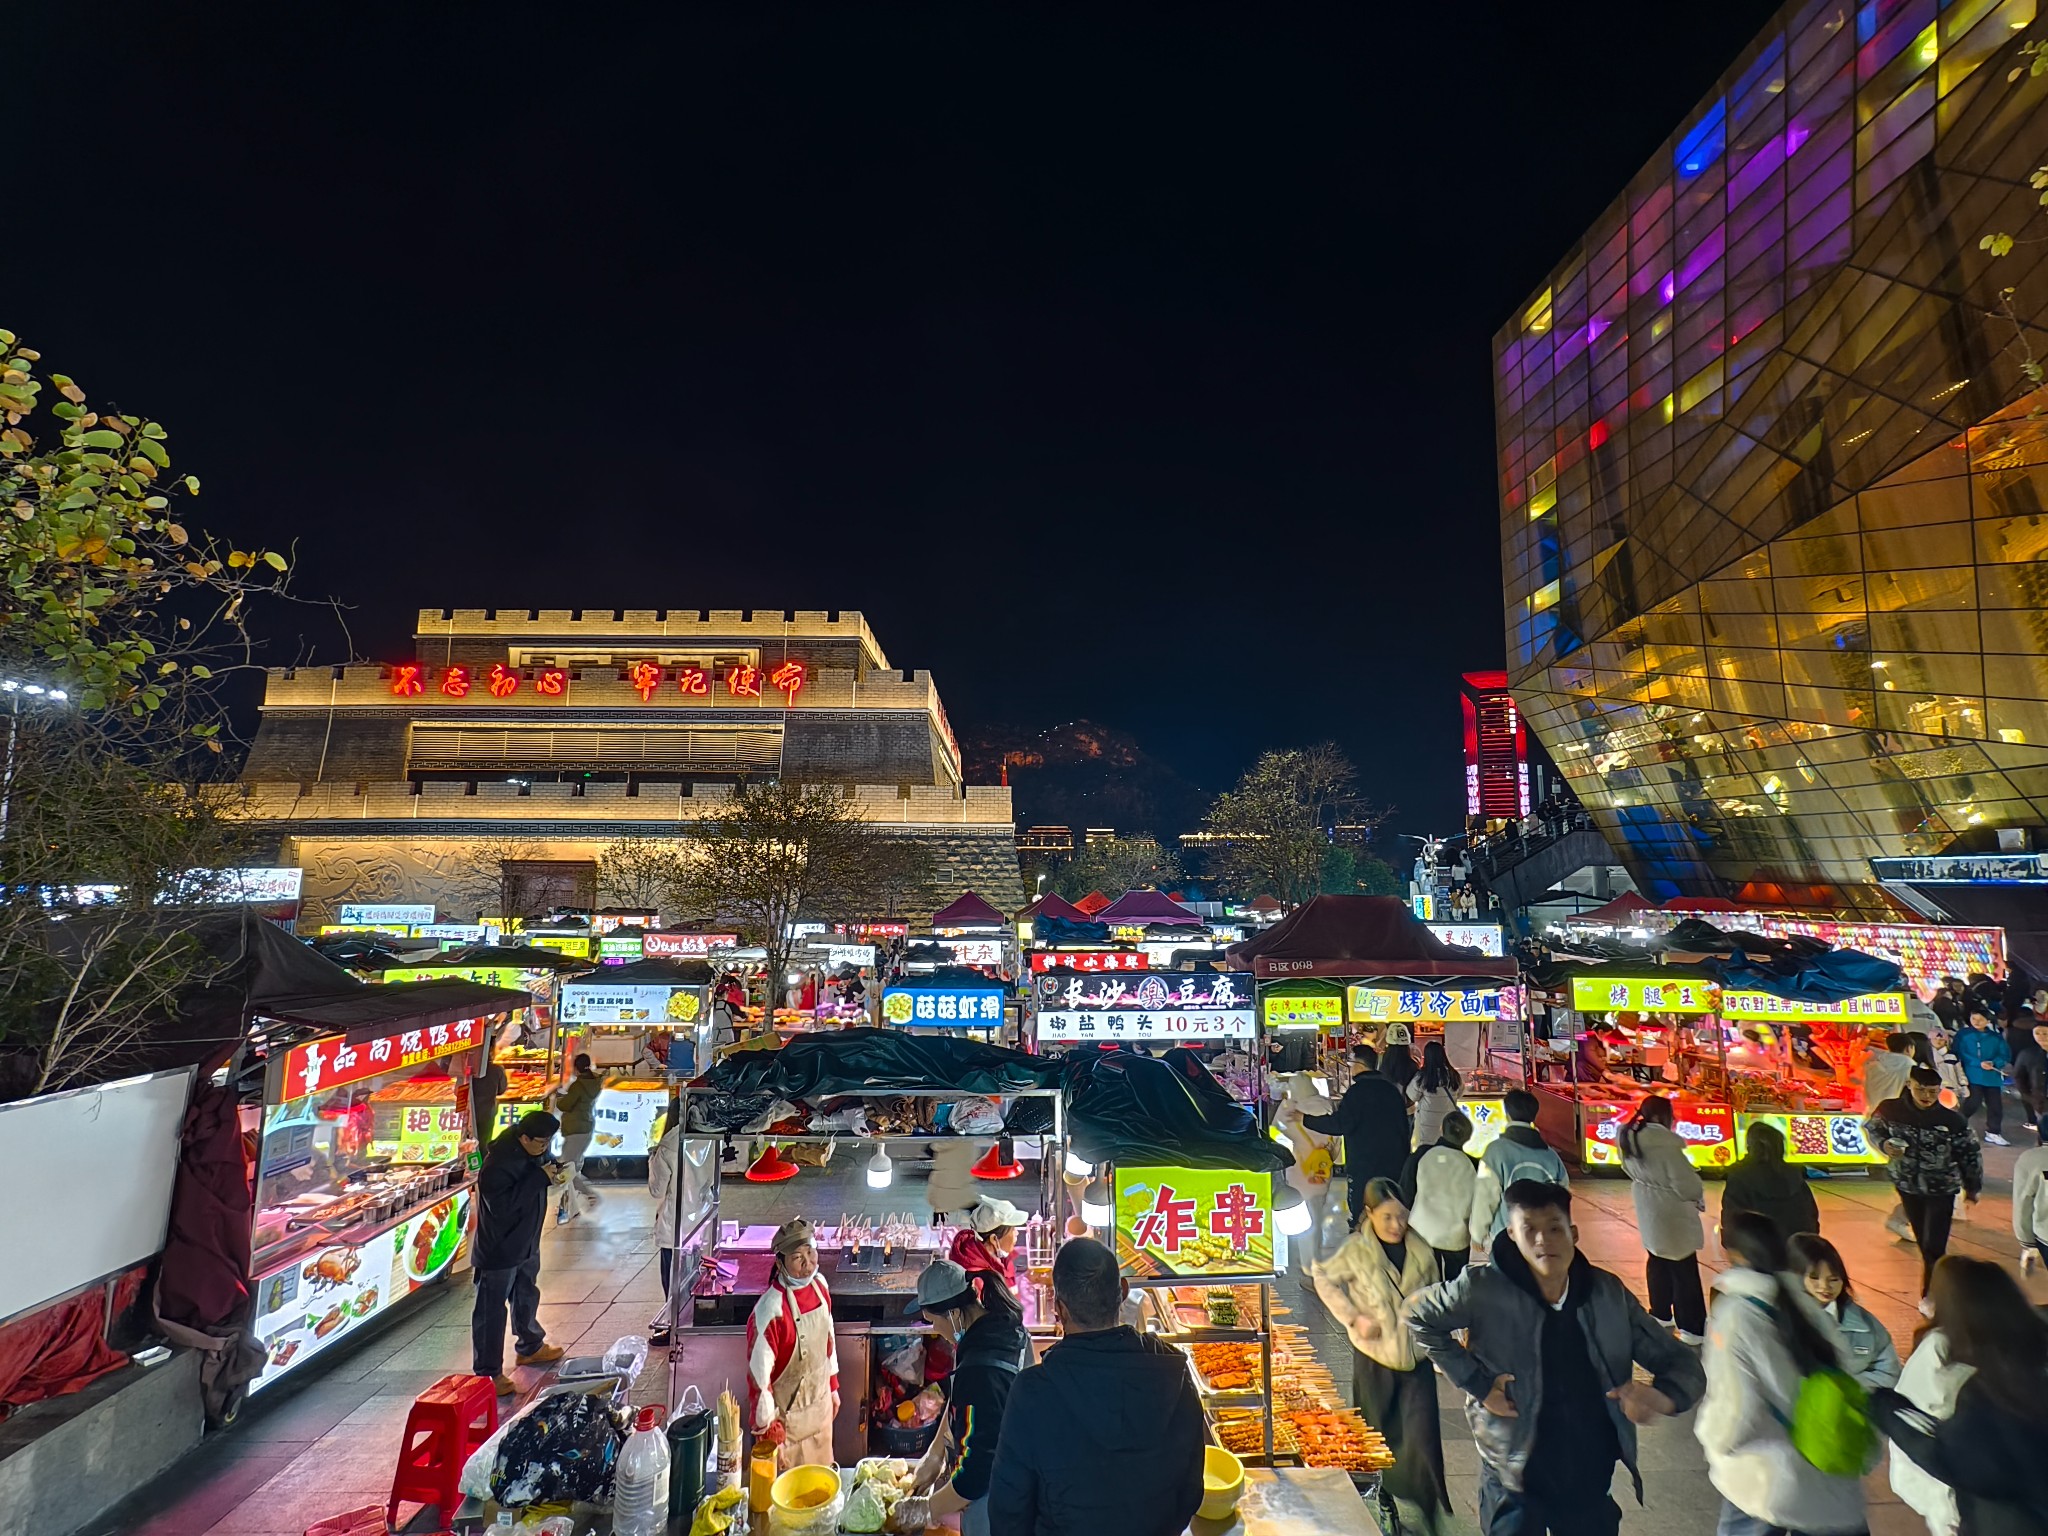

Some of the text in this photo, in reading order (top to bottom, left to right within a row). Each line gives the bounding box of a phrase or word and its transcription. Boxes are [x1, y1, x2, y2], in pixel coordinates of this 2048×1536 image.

[392, 663, 803, 707] 不忘初心 牢记使命
[916, 994, 1000, 1019] 菇菇虾滑
[1063, 975, 1235, 1010] 长沙臭豆腐
[1610, 983, 1694, 1007] 烤腿王
[1050, 1015, 1246, 1033] 椒盐鸭头 10元3个
[1133, 1184, 1265, 1253] 炸串
